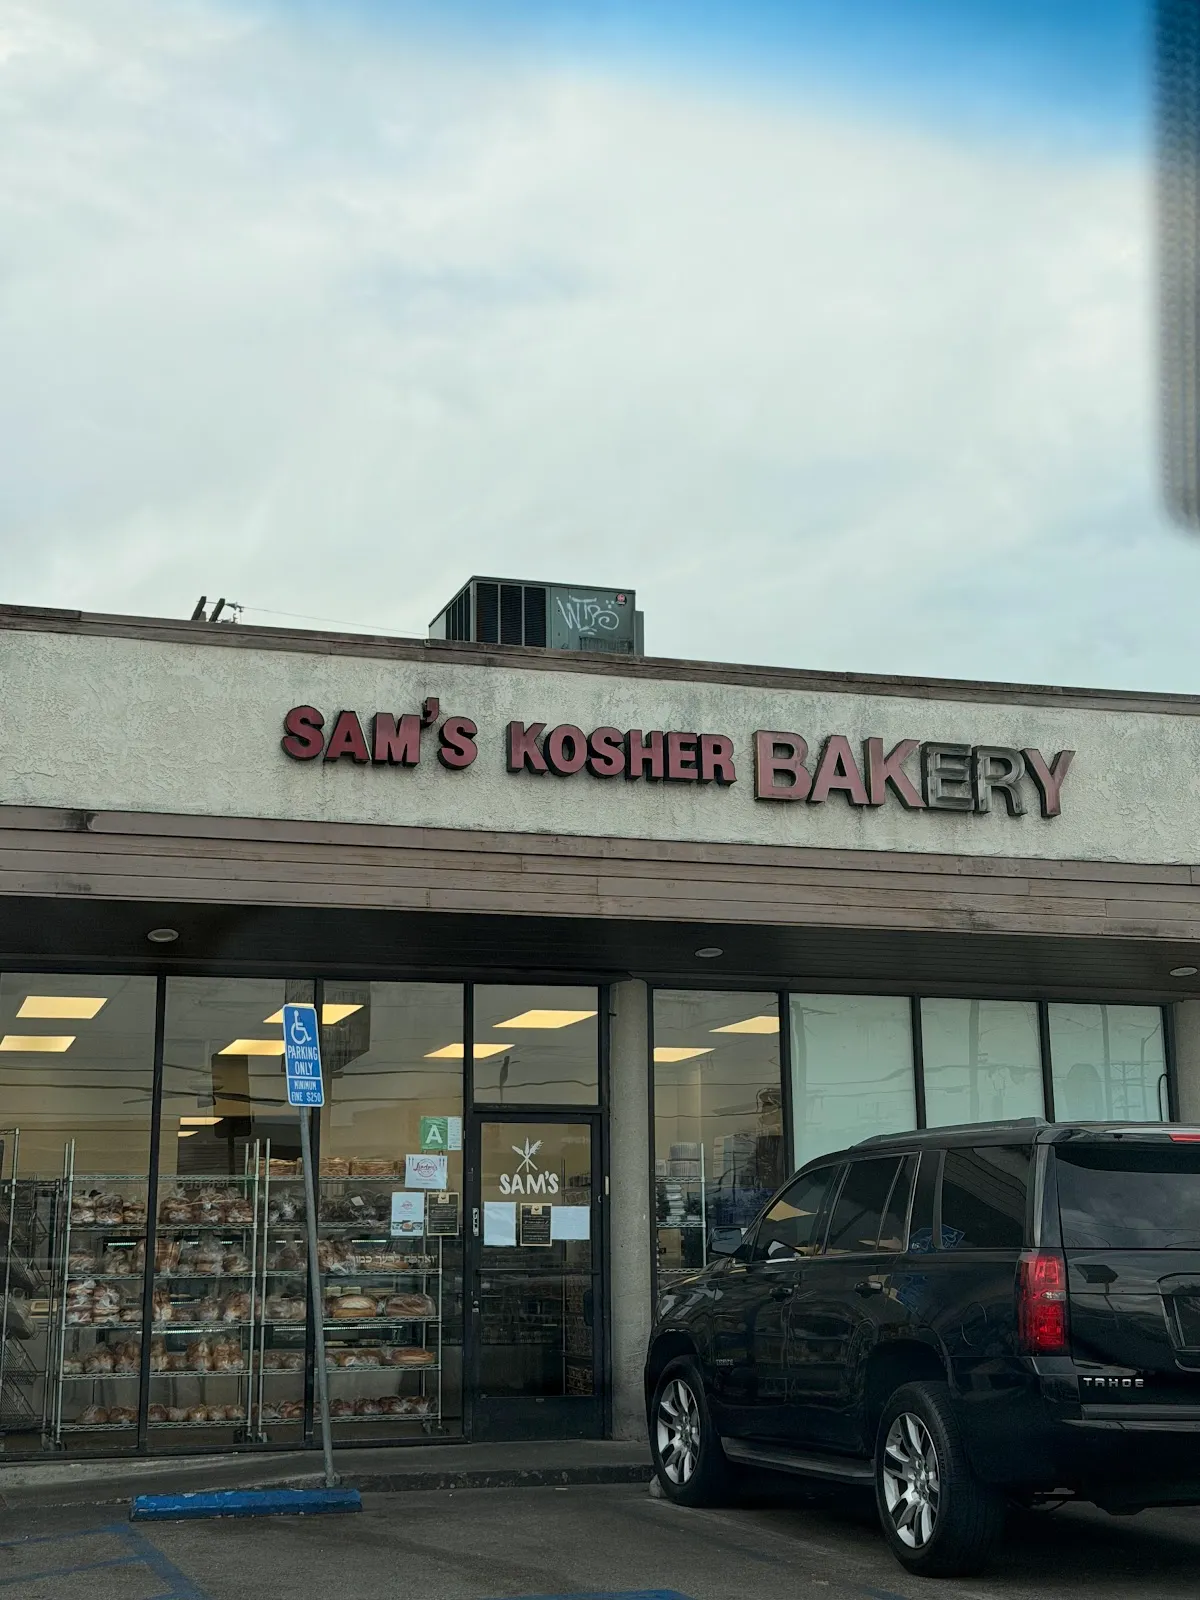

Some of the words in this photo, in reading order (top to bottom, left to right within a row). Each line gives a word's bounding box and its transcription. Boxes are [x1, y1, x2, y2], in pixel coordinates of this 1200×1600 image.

[281, 697, 478, 770] SAM'S
[507, 720, 737, 786] KOSHER
[753, 729, 1077, 818] BAKERY
[287, 1045, 318, 1061] PARKING
[294, 1061, 314, 1076] ONLY
[294, 1081, 317, 1091] MINIMUM
[291, 1091, 303, 1102] FINE
[306, 1092, 321, 1103] $250
[425, 1124, 443, 1144] A
[499, 1170, 559, 1195] SAM'S
[1083, 1377, 1144, 1388] TAHOE
